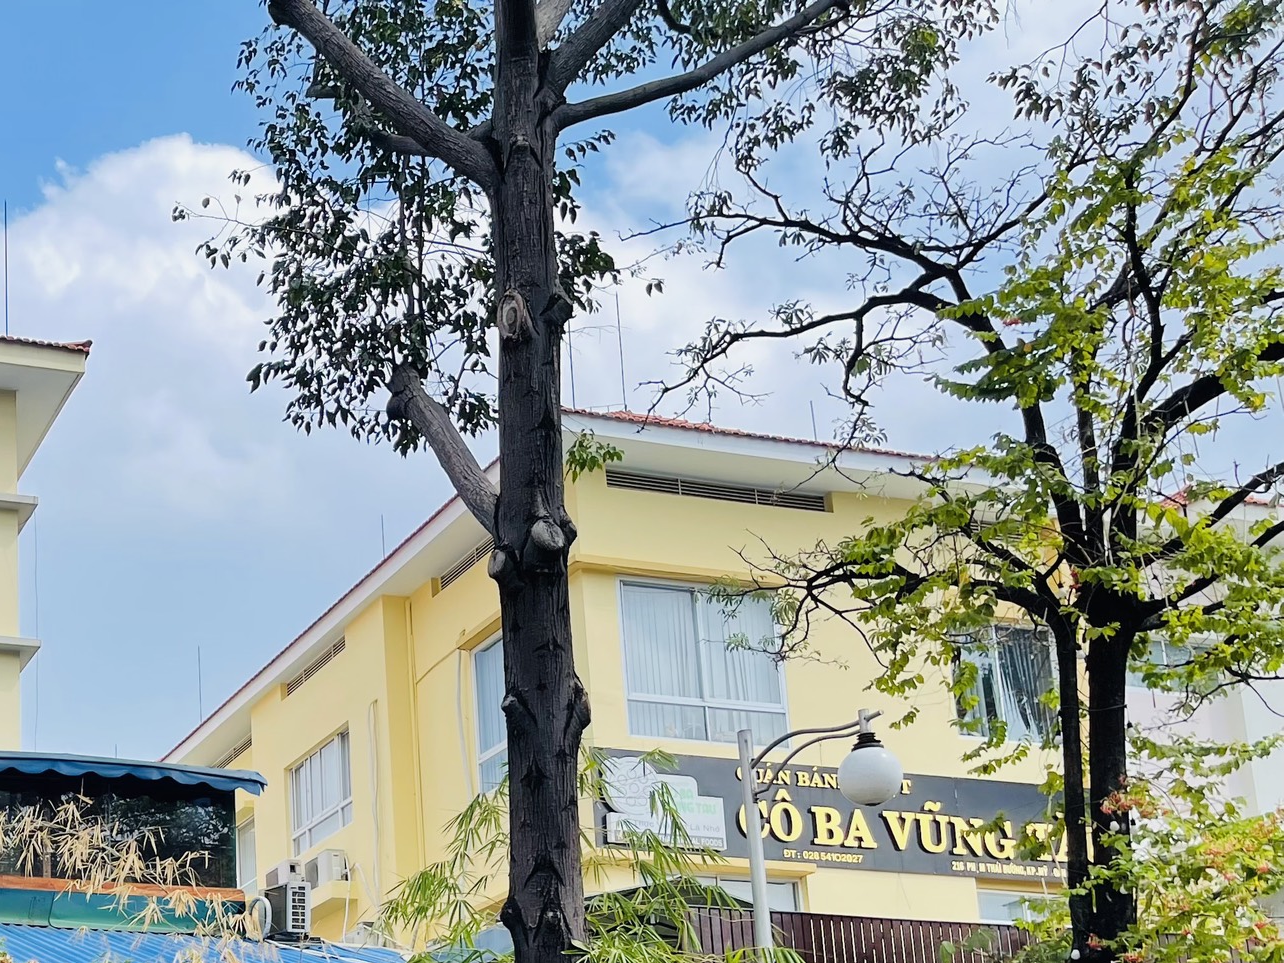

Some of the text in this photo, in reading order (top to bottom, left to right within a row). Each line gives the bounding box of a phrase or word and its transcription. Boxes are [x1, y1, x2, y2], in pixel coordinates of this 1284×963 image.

[796, 766, 840, 789] BÁN
[810, 805, 878, 849] BA
[882, 800, 1017, 860] VŨNG
